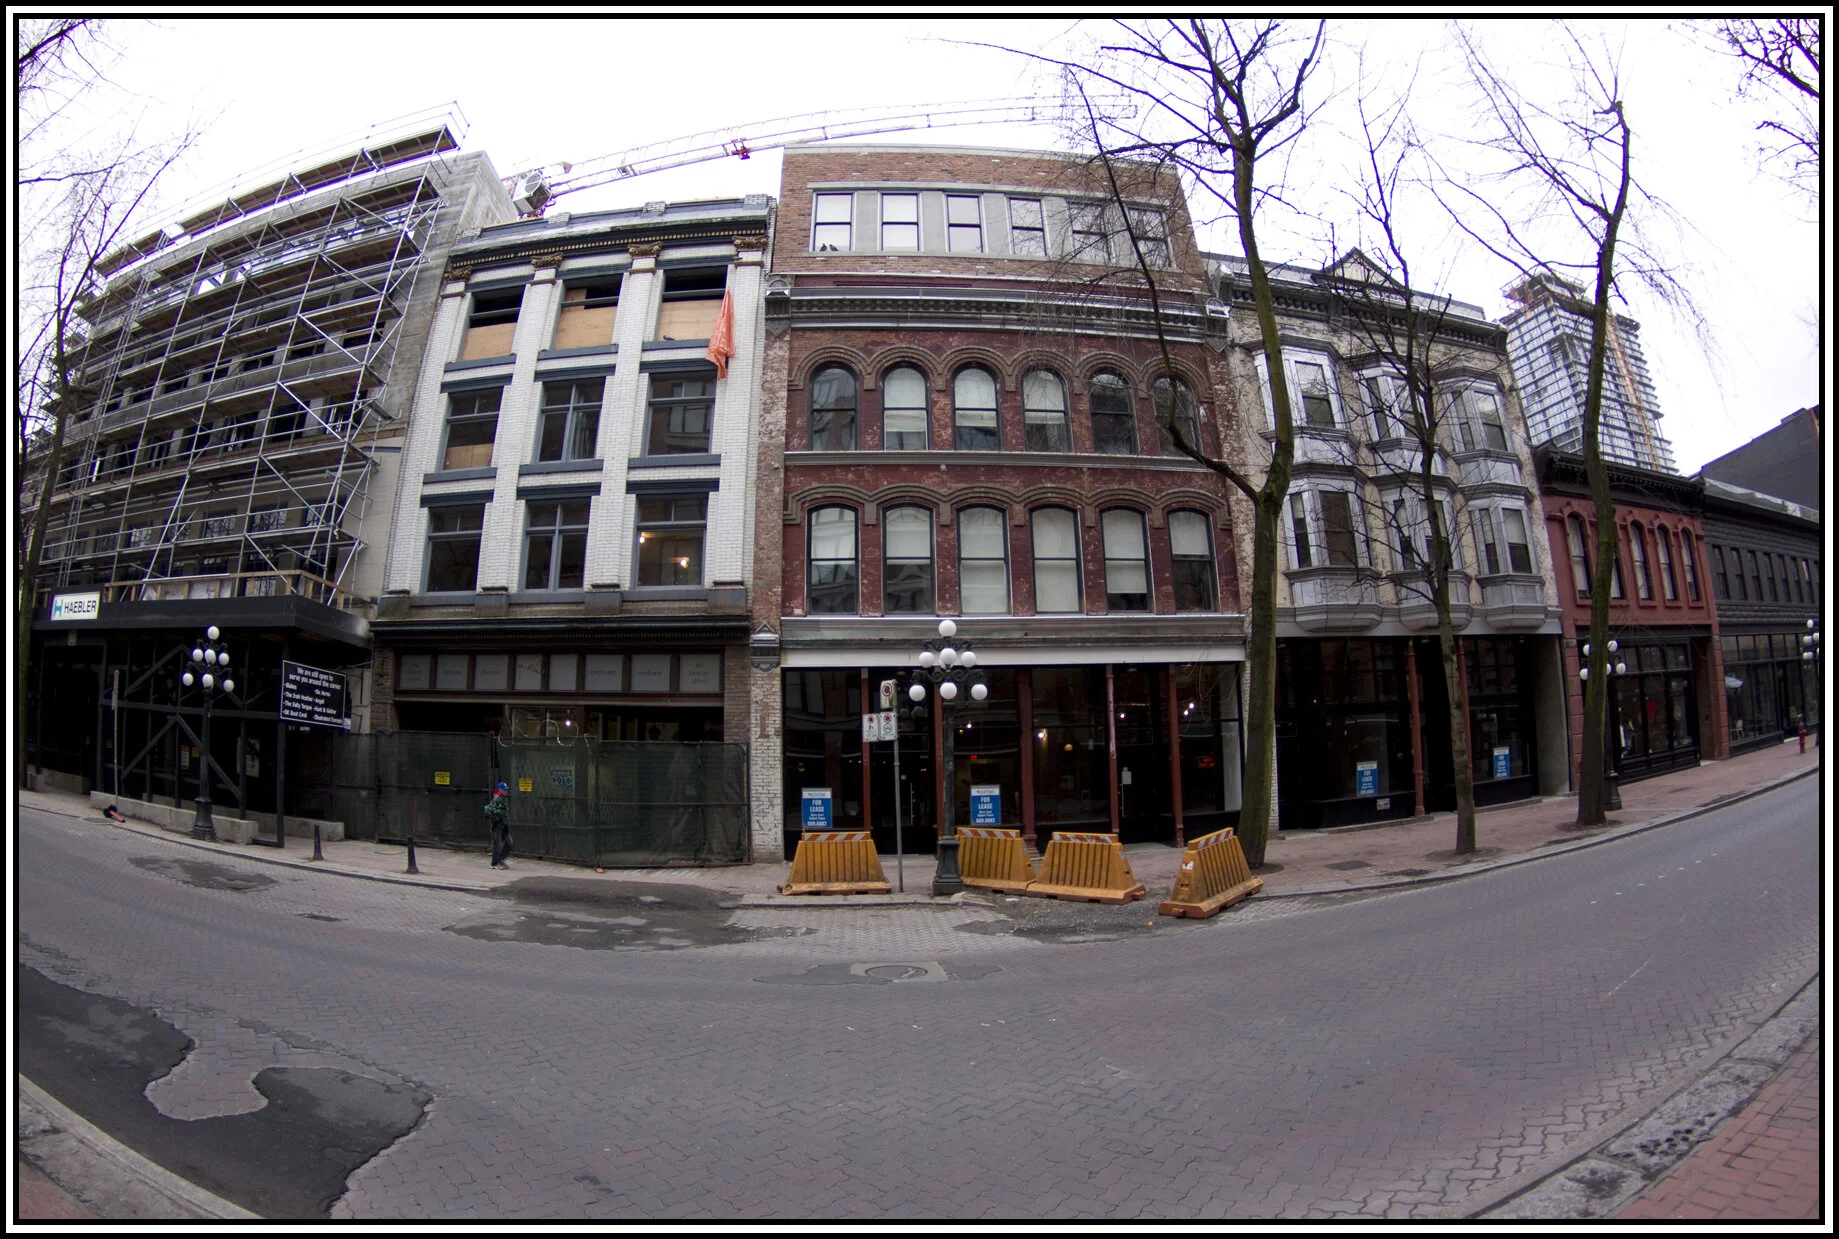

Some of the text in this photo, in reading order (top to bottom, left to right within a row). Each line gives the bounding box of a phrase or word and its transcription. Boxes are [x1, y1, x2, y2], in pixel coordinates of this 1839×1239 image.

[64, 600, 97, 614] HAEBLER
[297, 667, 303, 675] We
[289, 673, 300, 681] serve
[309, 678, 321, 686] around
[330, 682, 341, 690] corner
